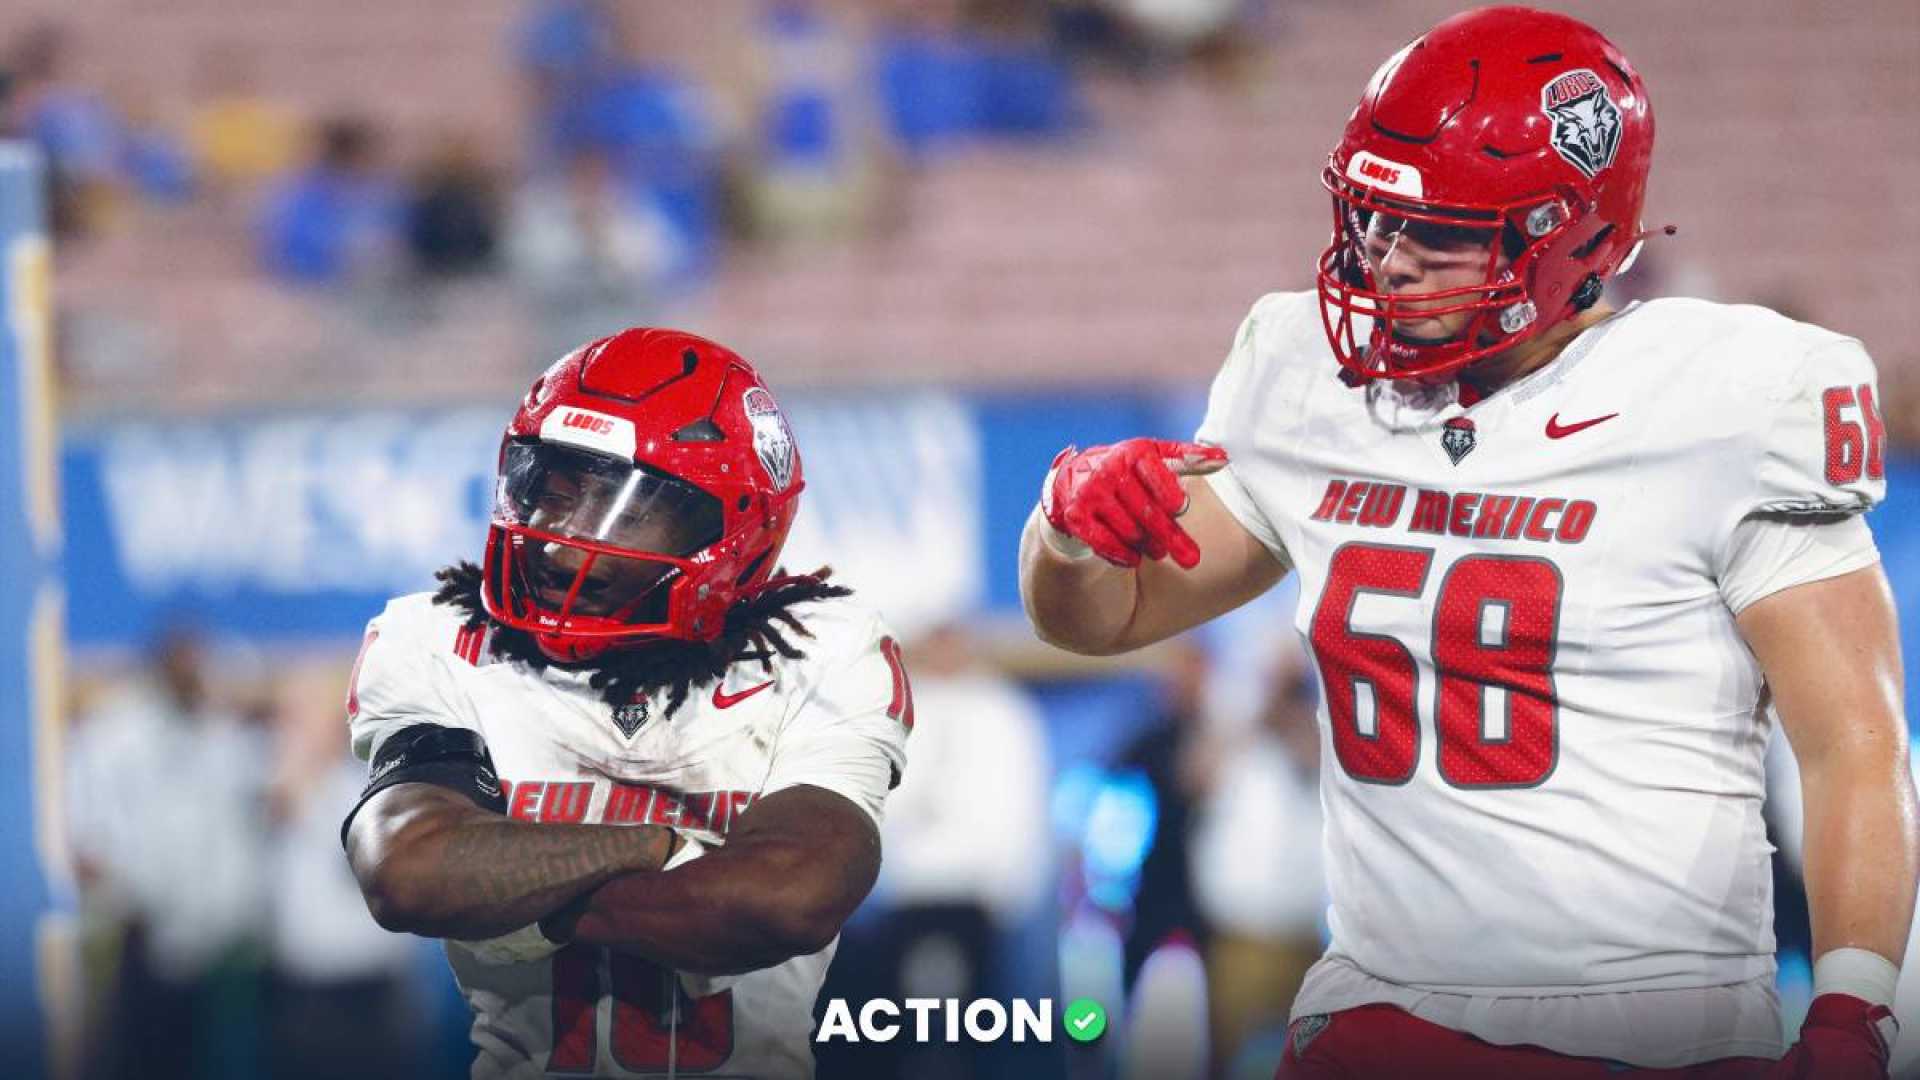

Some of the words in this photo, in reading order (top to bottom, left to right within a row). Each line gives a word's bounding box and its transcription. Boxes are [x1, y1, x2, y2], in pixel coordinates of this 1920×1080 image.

[1546, 71, 1601, 108] LOBOS
[1359, 159, 1401, 185] LOBOS
[562, 412, 615, 435] LOBOS
[1310, 480, 1407, 528] NEW
[1408, 488, 1597, 544] MEXICO
[1308, 540, 1564, 791] 68
